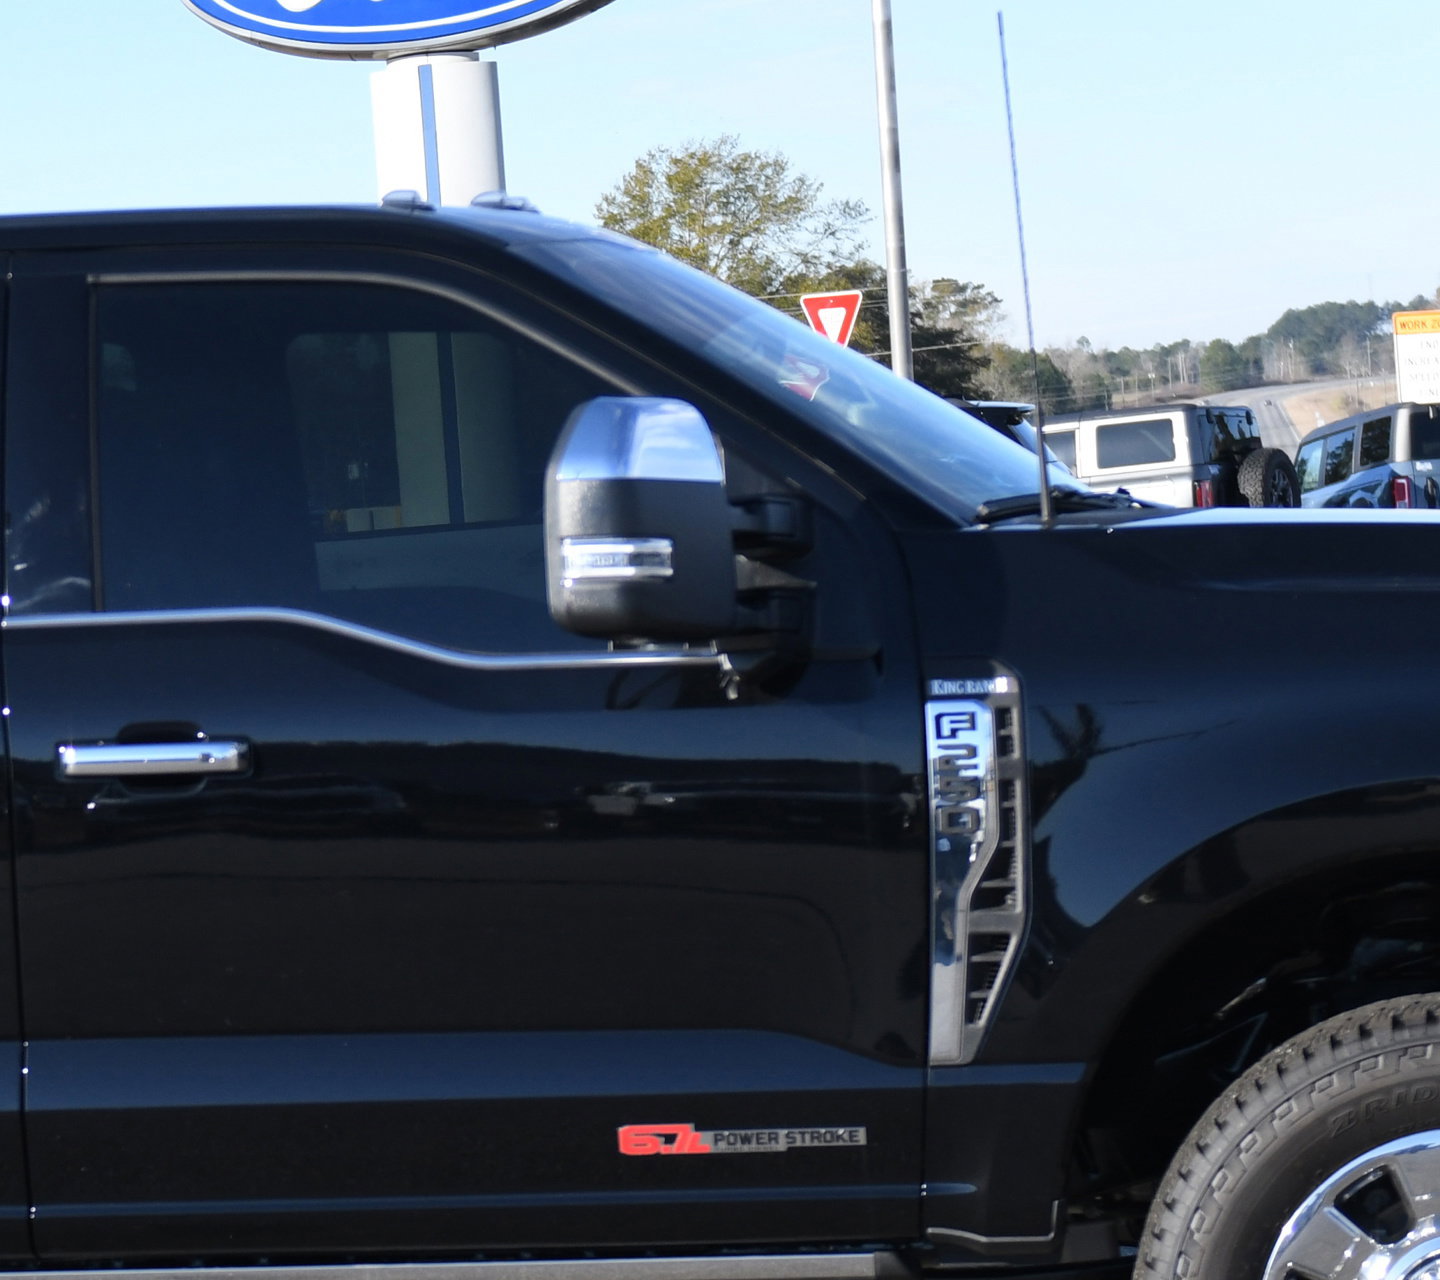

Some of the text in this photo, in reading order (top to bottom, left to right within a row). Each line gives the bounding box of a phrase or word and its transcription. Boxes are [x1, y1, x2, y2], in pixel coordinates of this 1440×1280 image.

[1399, 319, 1428, 330] WORK
[930, 679, 965, 696] KING
[618, 1123, 712, 1155] 6.7L
[714, 1131, 780, 1147] POWER
[785, 1128, 861, 1145] STROKE
